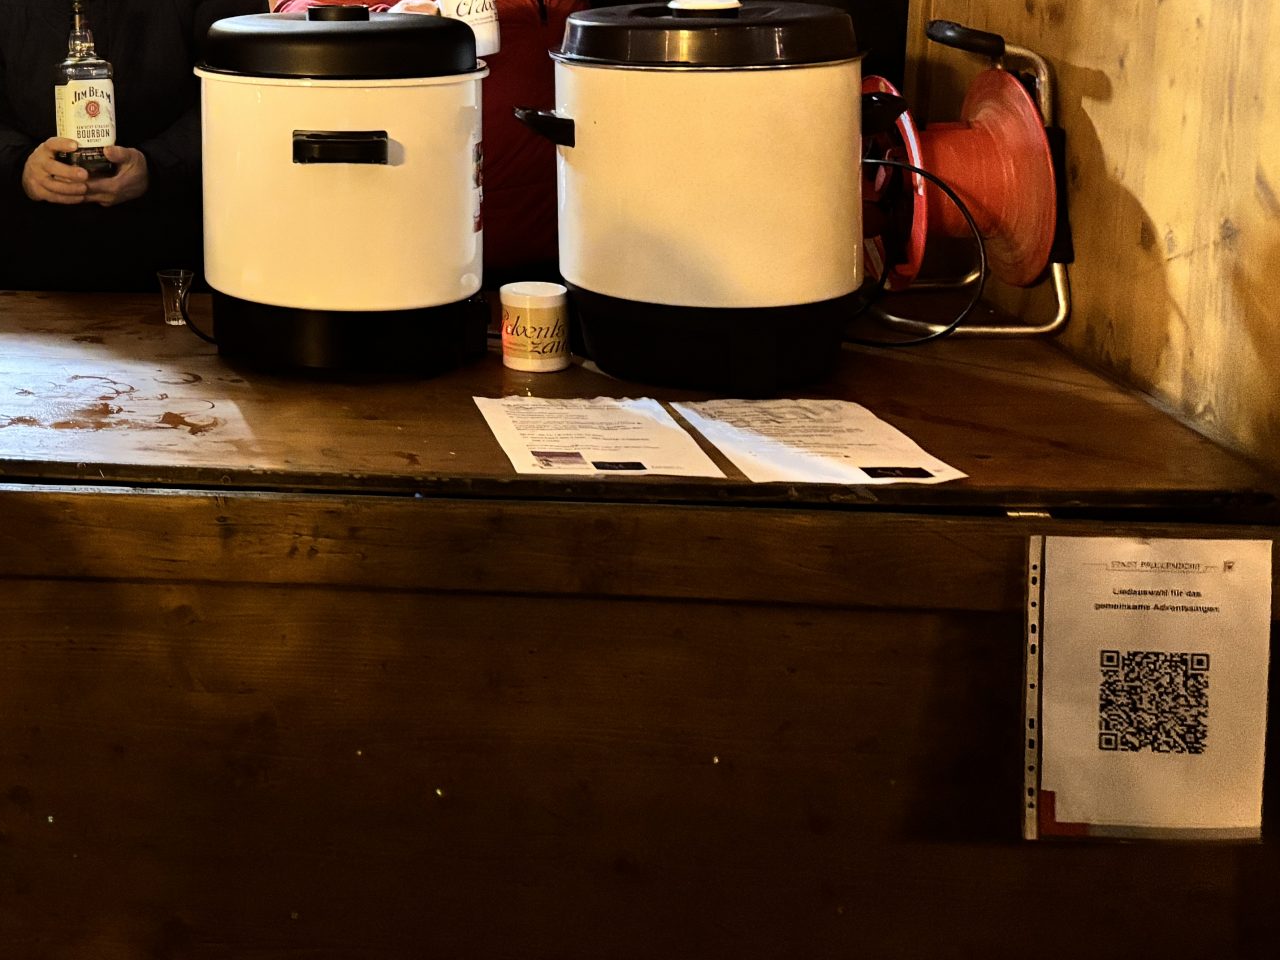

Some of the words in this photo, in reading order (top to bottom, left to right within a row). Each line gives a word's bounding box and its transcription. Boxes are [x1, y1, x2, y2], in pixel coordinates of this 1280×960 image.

[71, 89, 87, 105] JIM
[88, 86, 112, 104] BEAM
[76, 128, 110, 139] BOURBON
